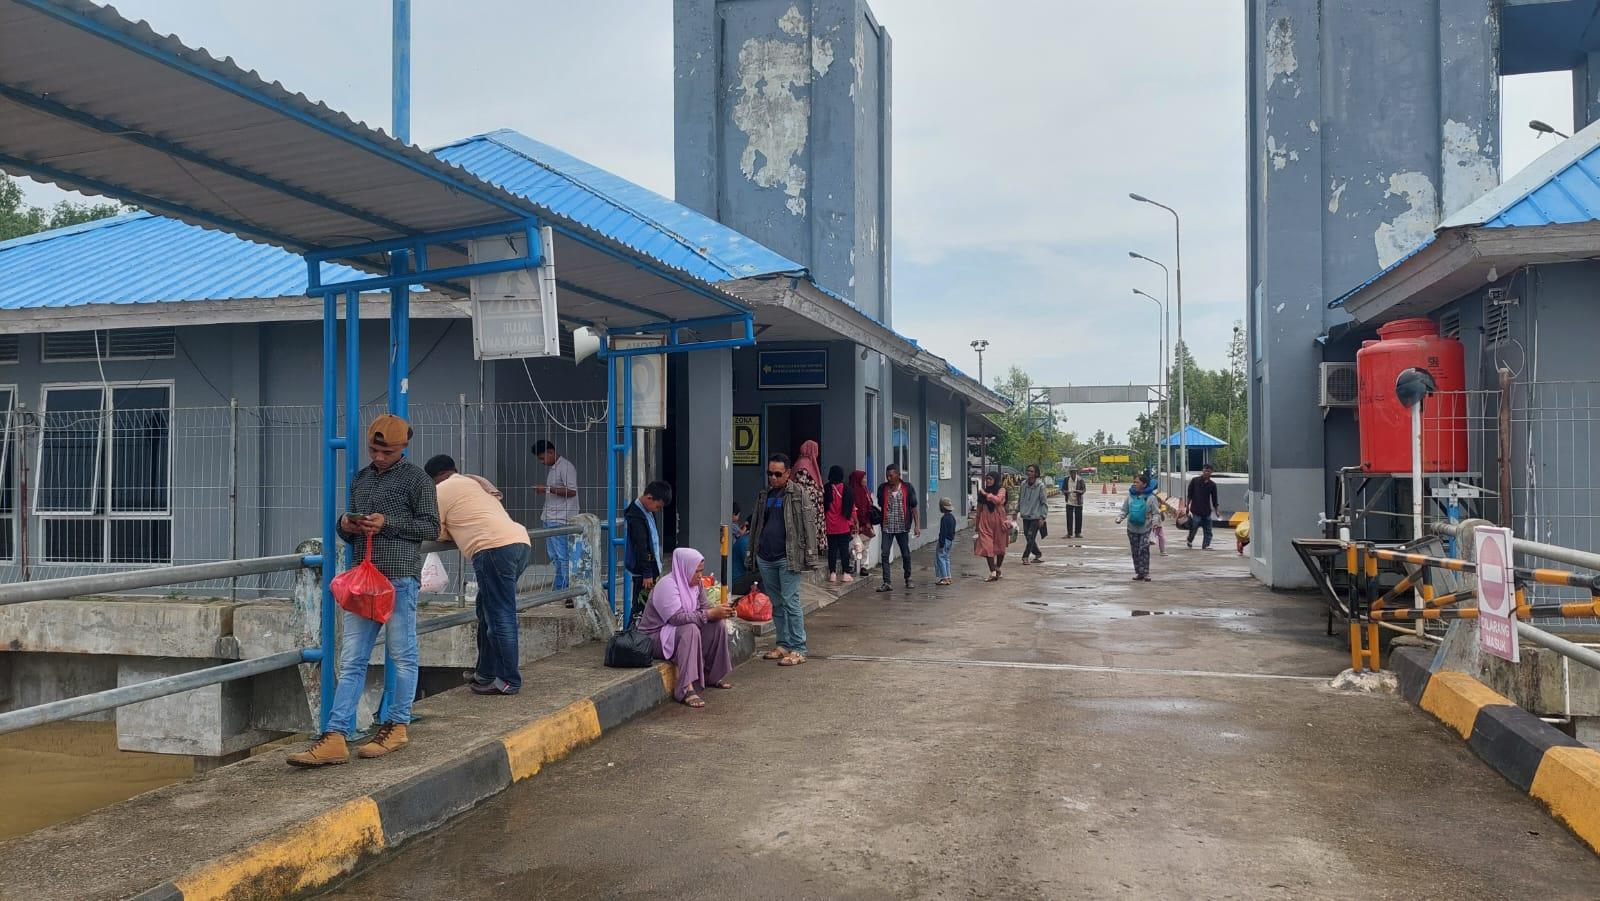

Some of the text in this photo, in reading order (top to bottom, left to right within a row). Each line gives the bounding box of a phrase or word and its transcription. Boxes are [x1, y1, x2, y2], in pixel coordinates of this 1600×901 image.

[735, 425, 754, 451] D
[1481, 616, 1510, 638] DILARANG
[1485, 634, 1507, 653] MASUK
